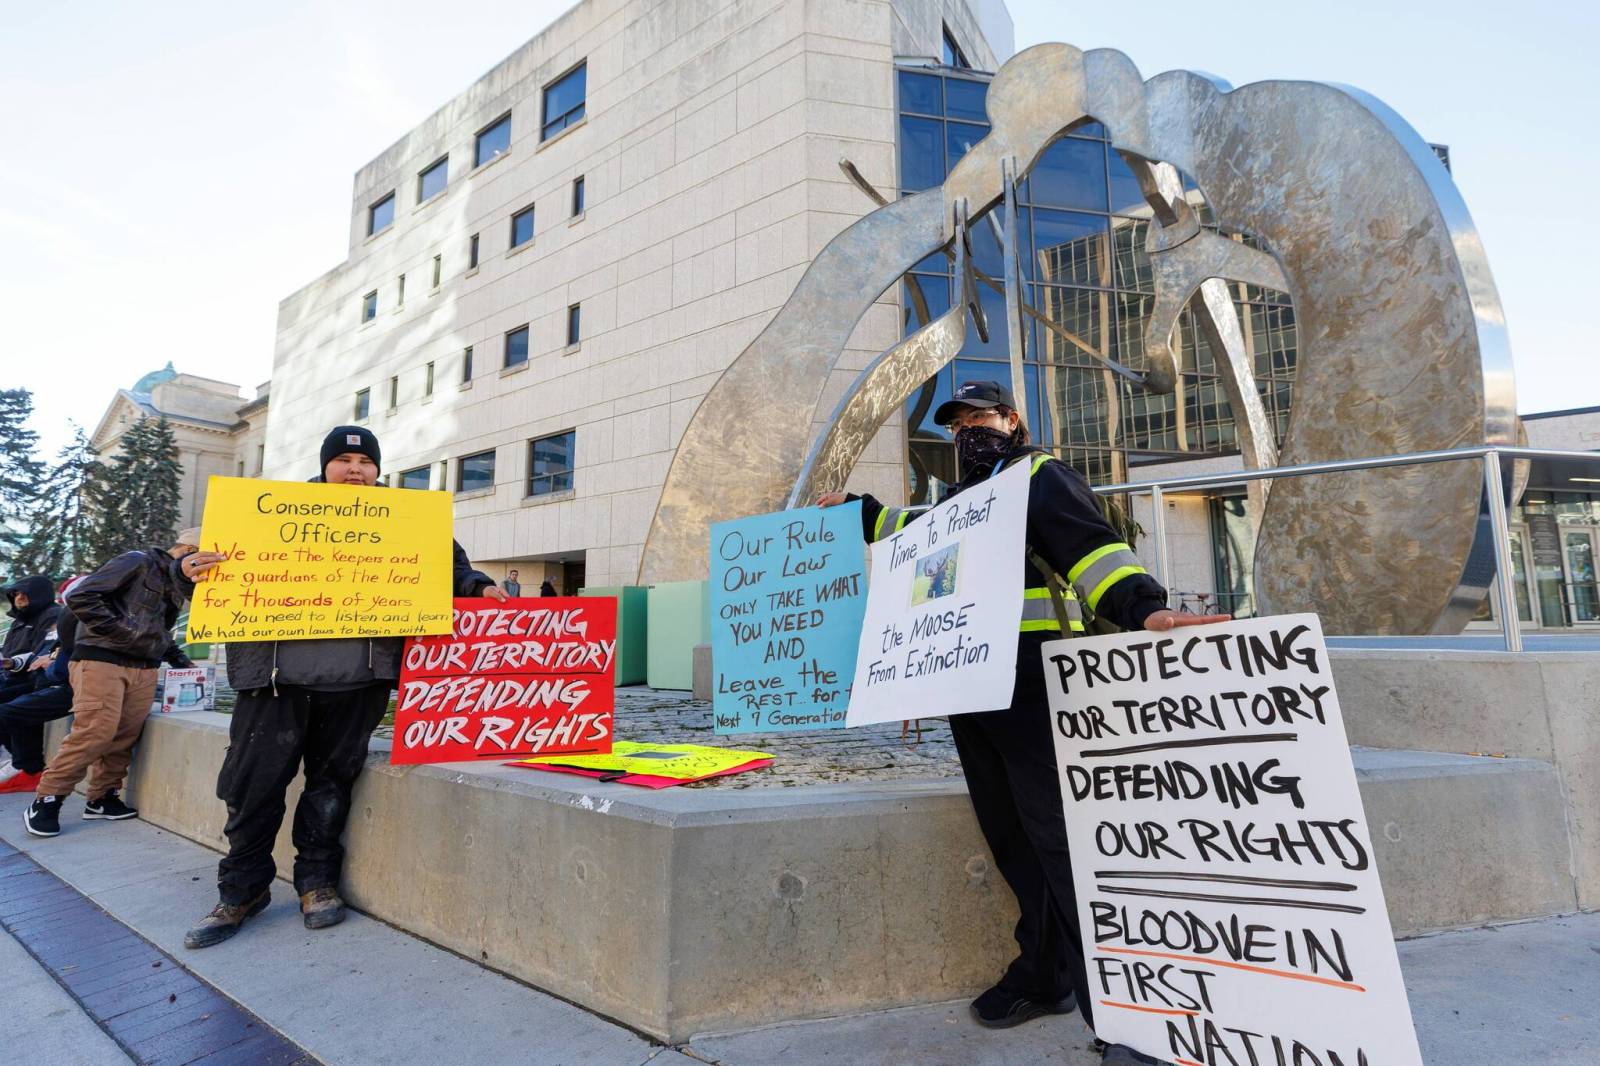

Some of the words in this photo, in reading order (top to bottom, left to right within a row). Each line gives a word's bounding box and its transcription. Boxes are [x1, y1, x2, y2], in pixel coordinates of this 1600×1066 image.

[257, 493, 390, 517] Conservation
[280, 522, 382, 543] Officers
[720, 531, 774, 561] Our
[782, 517, 835, 549] Rule
[889, 533, 918, 573] Time
[946, 488, 997, 536] Protect
[214, 542, 246, 561] We
[258, 552, 288, 561] are
[390, 554, 418, 564] and
[240, 570, 318, 587] guardians
[326, 568, 344, 582] of
[387, 569, 420, 584] land
[724, 566, 767, 592] Our
[782, 553, 832, 577] Law
[204, 588, 230, 608] for
[239, 588, 332, 608] thousands
[342, 592, 364, 607] of
[364, 595, 413, 613] years
[720, 600, 757, 619] ONLY
[767, 588, 805, 610] TAKE
[816, 573, 861, 603] WHAT
[190, 624, 213, 640] We
[217, 626, 245, 638] had
[252, 628, 274, 637] our
[277, 628, 305, 637] own
[309, 625, 334, 635] laws
[341, 625, 353, 634] to
[358, 625, 391, 636] begin
[399, 625, 426, 634] with
[231, 610, 258, 626] You
[265, 609, 303, 623] need
[308, 611, 326, 622] to
[335, 608, 378, 622] listen
[382, 612, 409, 622] and
[418, 608, 449, 622] learn
[452, 608, 588, 641] OTECTING
[730, 622, 762, 646] YOU
[770, 609, 824, 637] NEED
[882, 624, 904, 654] the
[910, 602, 976, 643] MOOSE
[405, 643, 468, 672] OUR
[468, 639, 616, 673] TERRITORY
[763, 637, 805, 663] AND
[867, 660, 896, 687] From
[904, 634, 990, 679] Extinction
[1049, 625, 1321, 694] PROTECTING
[719, 673, 785, 694] Leave
[798, 658, 838, 688] the
[401, 677, 591, 714] DEFENDING
[812, 688, 840, 703] for
[1057, 705, 1120, 740] OUR
[1113, 683, 1330, 734] TERRITORY
[404, 716, 470, 749] OUR
[474, 712, 612, 752] RIGHTS
[716, 711, 741, 729] Next
[752, 711, 760, 727] 7
[1066, 758, 1305, 809] DEFENDING
[1095, 820, 1187, 860] OUR
[1178, 819, 1369, 871] RIGHTS
[1089, 901, 1353, 982] BLOODVEIN
[1092, 957, 1216, 1014] FIRST
